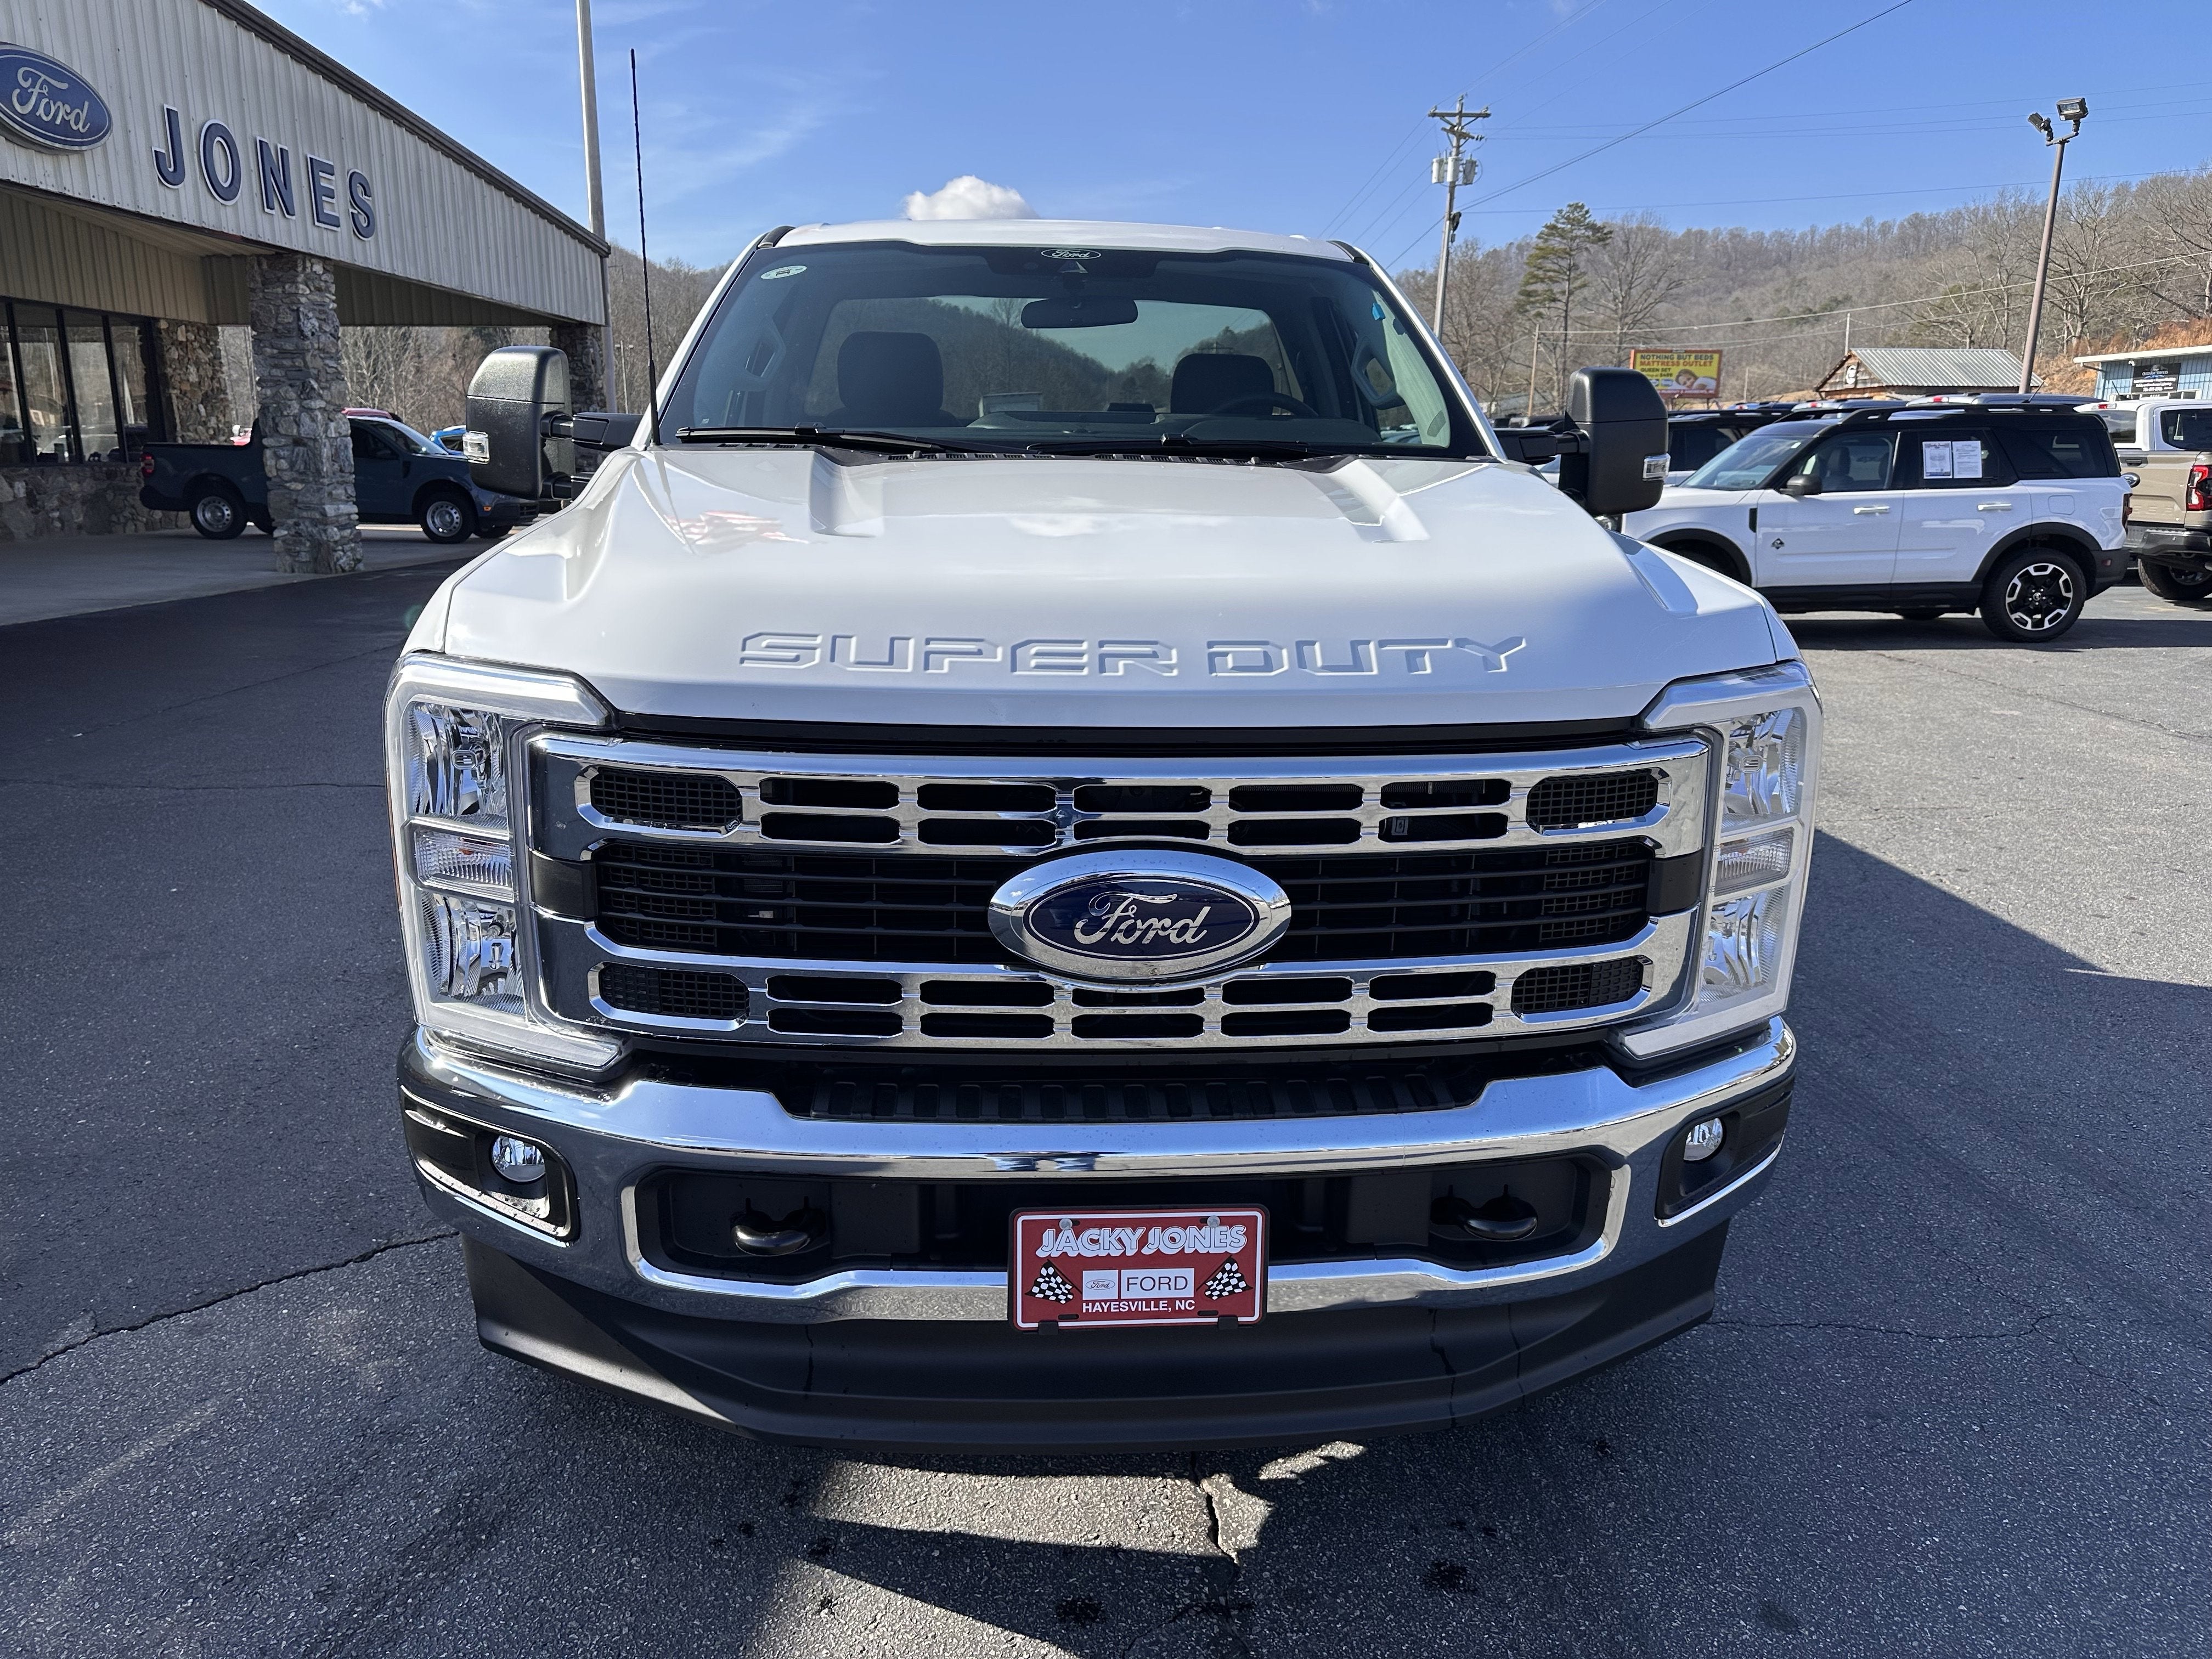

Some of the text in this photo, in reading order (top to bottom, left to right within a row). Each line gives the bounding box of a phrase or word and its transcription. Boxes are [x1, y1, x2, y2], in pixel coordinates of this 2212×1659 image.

[12, 66, 91, 134] Ford
[152, 104, 376, 241] JONES
[1052, 250, 1091, 258] Ford
[740, 632, 1527, 676] SUPER DUTY
[1074, 891, 1211, 945] Ford
[1036, 1225, 1248, 1257] JACKY JONES
[1127, 1276, 1188, 1291] FORD
[1082, 1300, 1195, 1313] HAYESVILLE, NC
